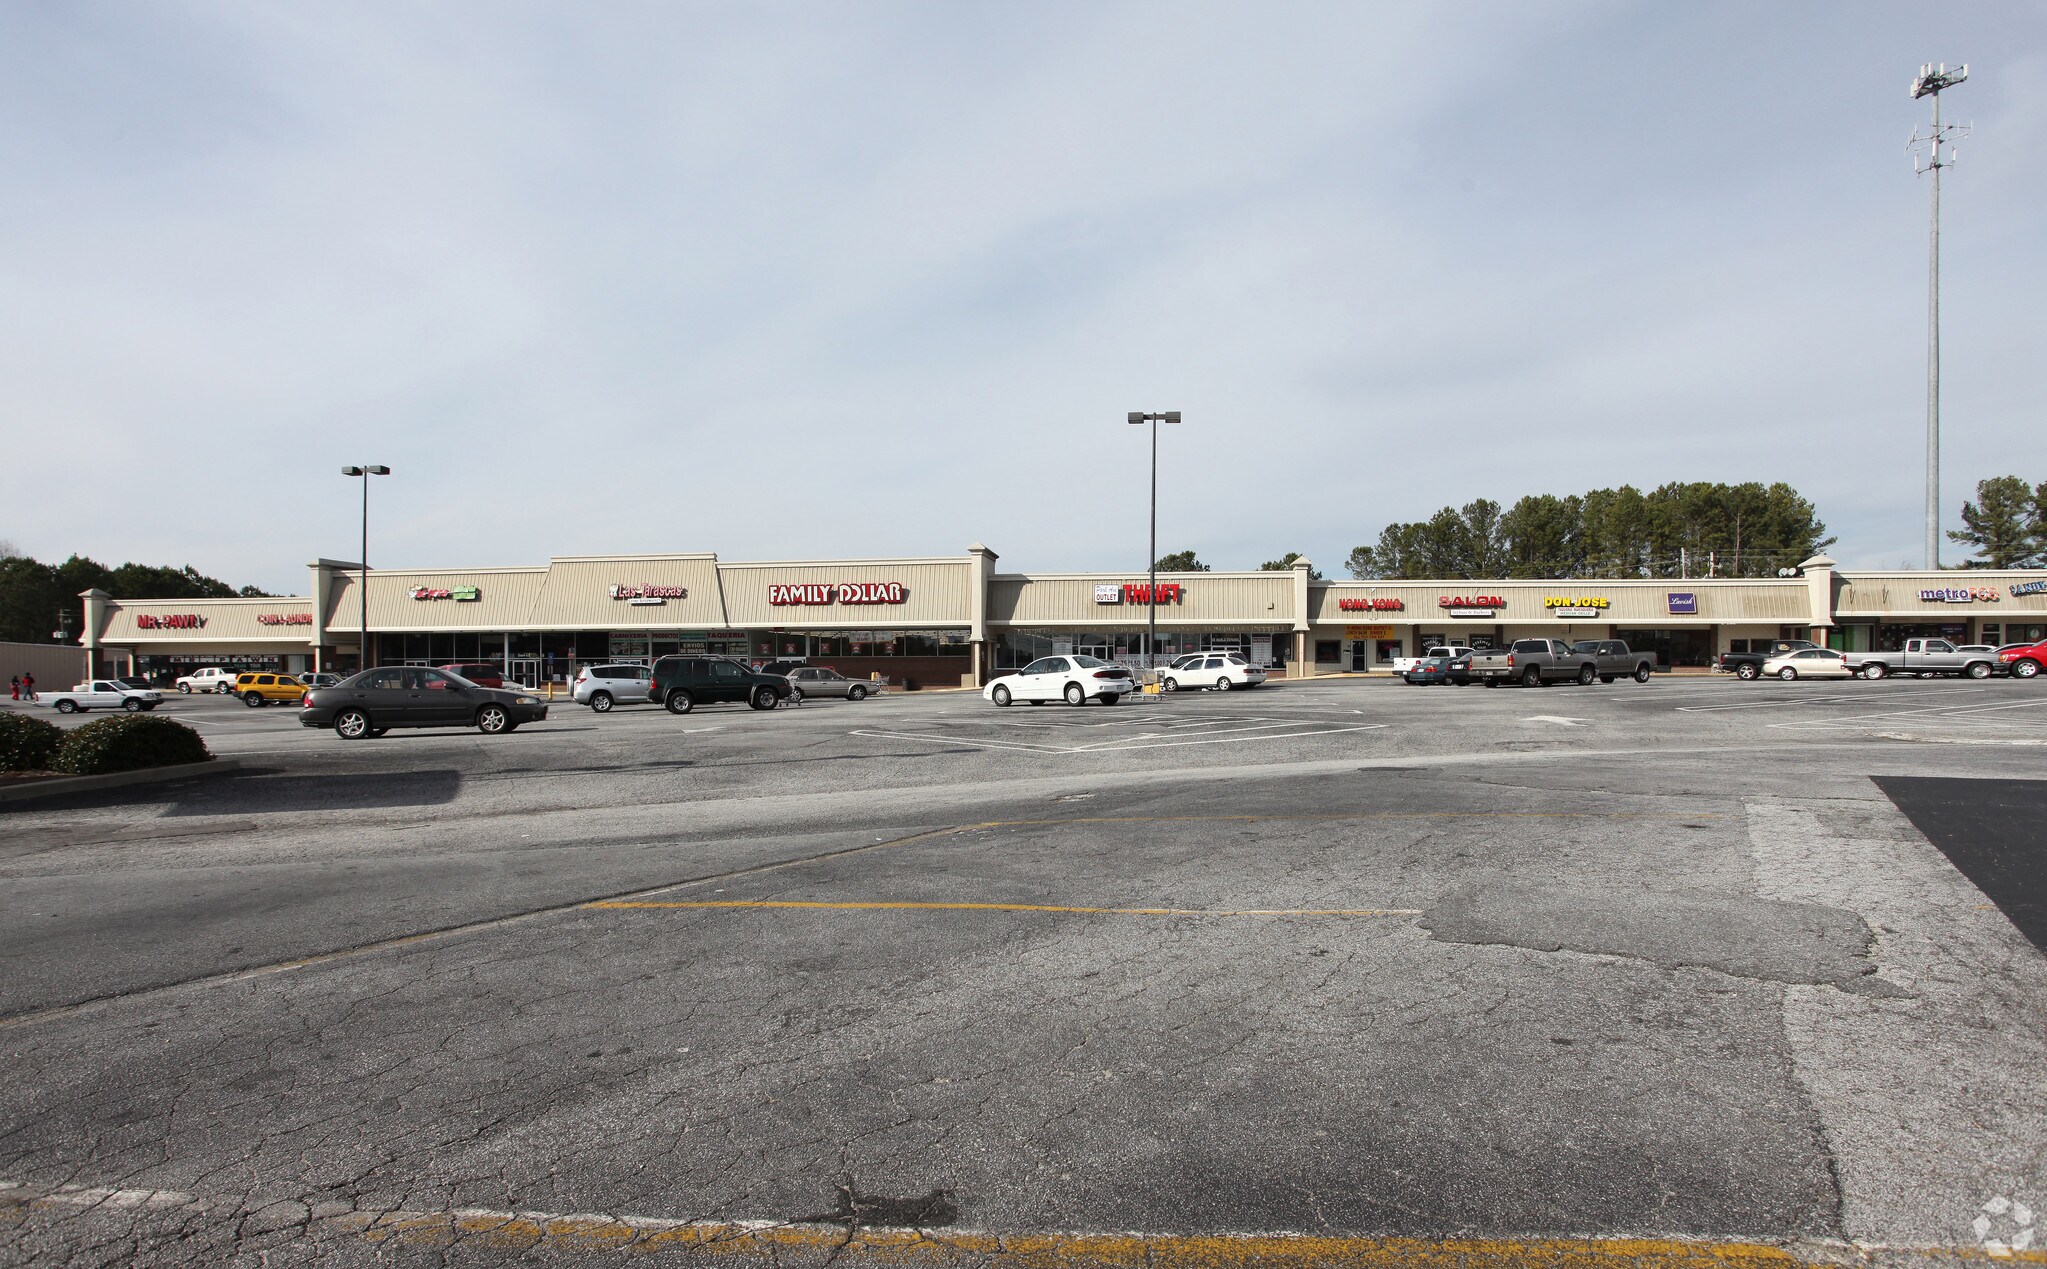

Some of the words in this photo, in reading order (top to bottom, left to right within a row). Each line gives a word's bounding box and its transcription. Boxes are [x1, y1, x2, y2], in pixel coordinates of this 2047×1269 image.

[619, 585, 636, 597] Las
[641, 583, 682, 597] Tarascas
[769, 585, 832, 604] FAMILY
[838, 582, 902, 603] DOLLAR
[1920, 587, 1999, 600] metroPCS
[1339, 598, 1368, 609] HONG
[1372, 598, 1401, 609] KONG
[1439, 596, 1502, 606] SALON
[1544, 597, 1571, 606] DON
[1574, 597, 1607, 606] JOSE
[1670, 597, 1693, 605] Lavish
